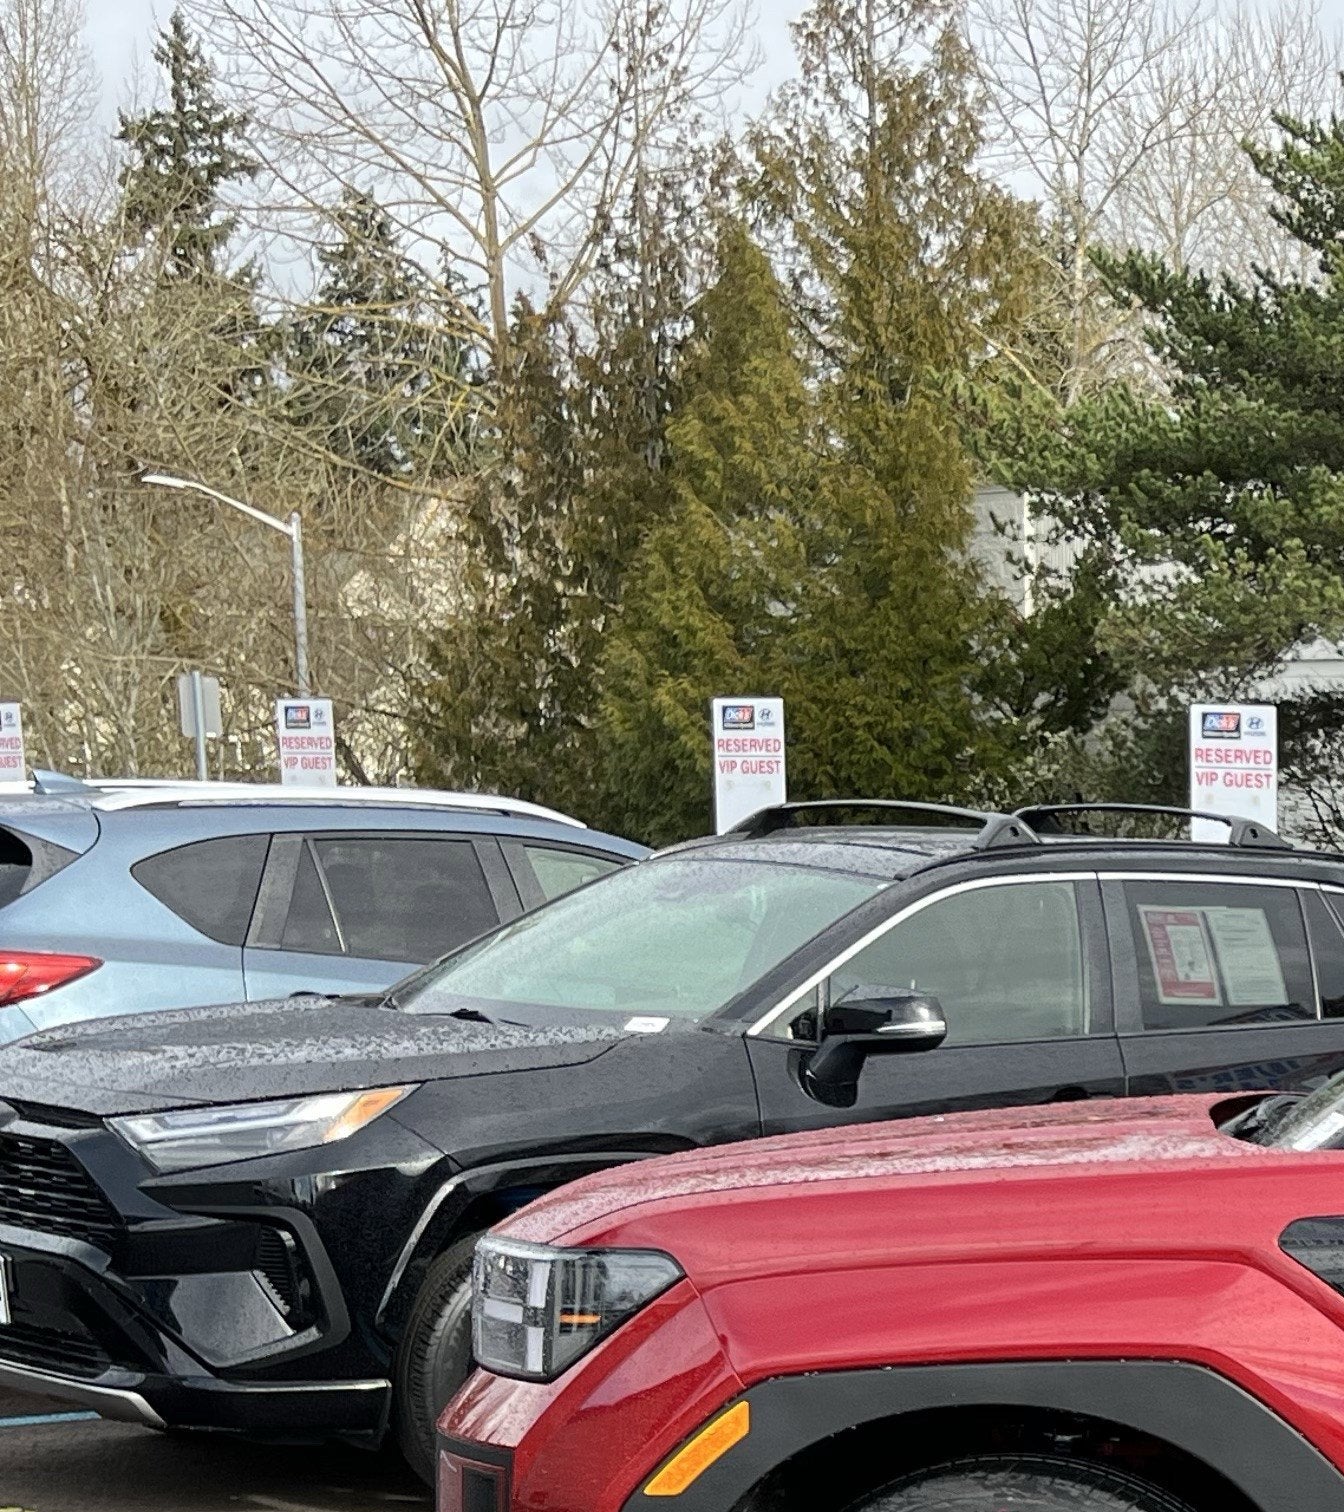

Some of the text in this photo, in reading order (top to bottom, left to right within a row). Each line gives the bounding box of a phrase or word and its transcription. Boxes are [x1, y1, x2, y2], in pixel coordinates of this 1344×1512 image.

[281, 736, 333, 750] RESERVED
[717, 738, 782, 753] RESERVED
[284, 756, 333, 770] VIP GUEST
[1194, 747, 1273, 765] RESERVED
[719, 760, 782, 775] VIP GUEST
[1195, 771, 1273, 789] VIP GUEST
